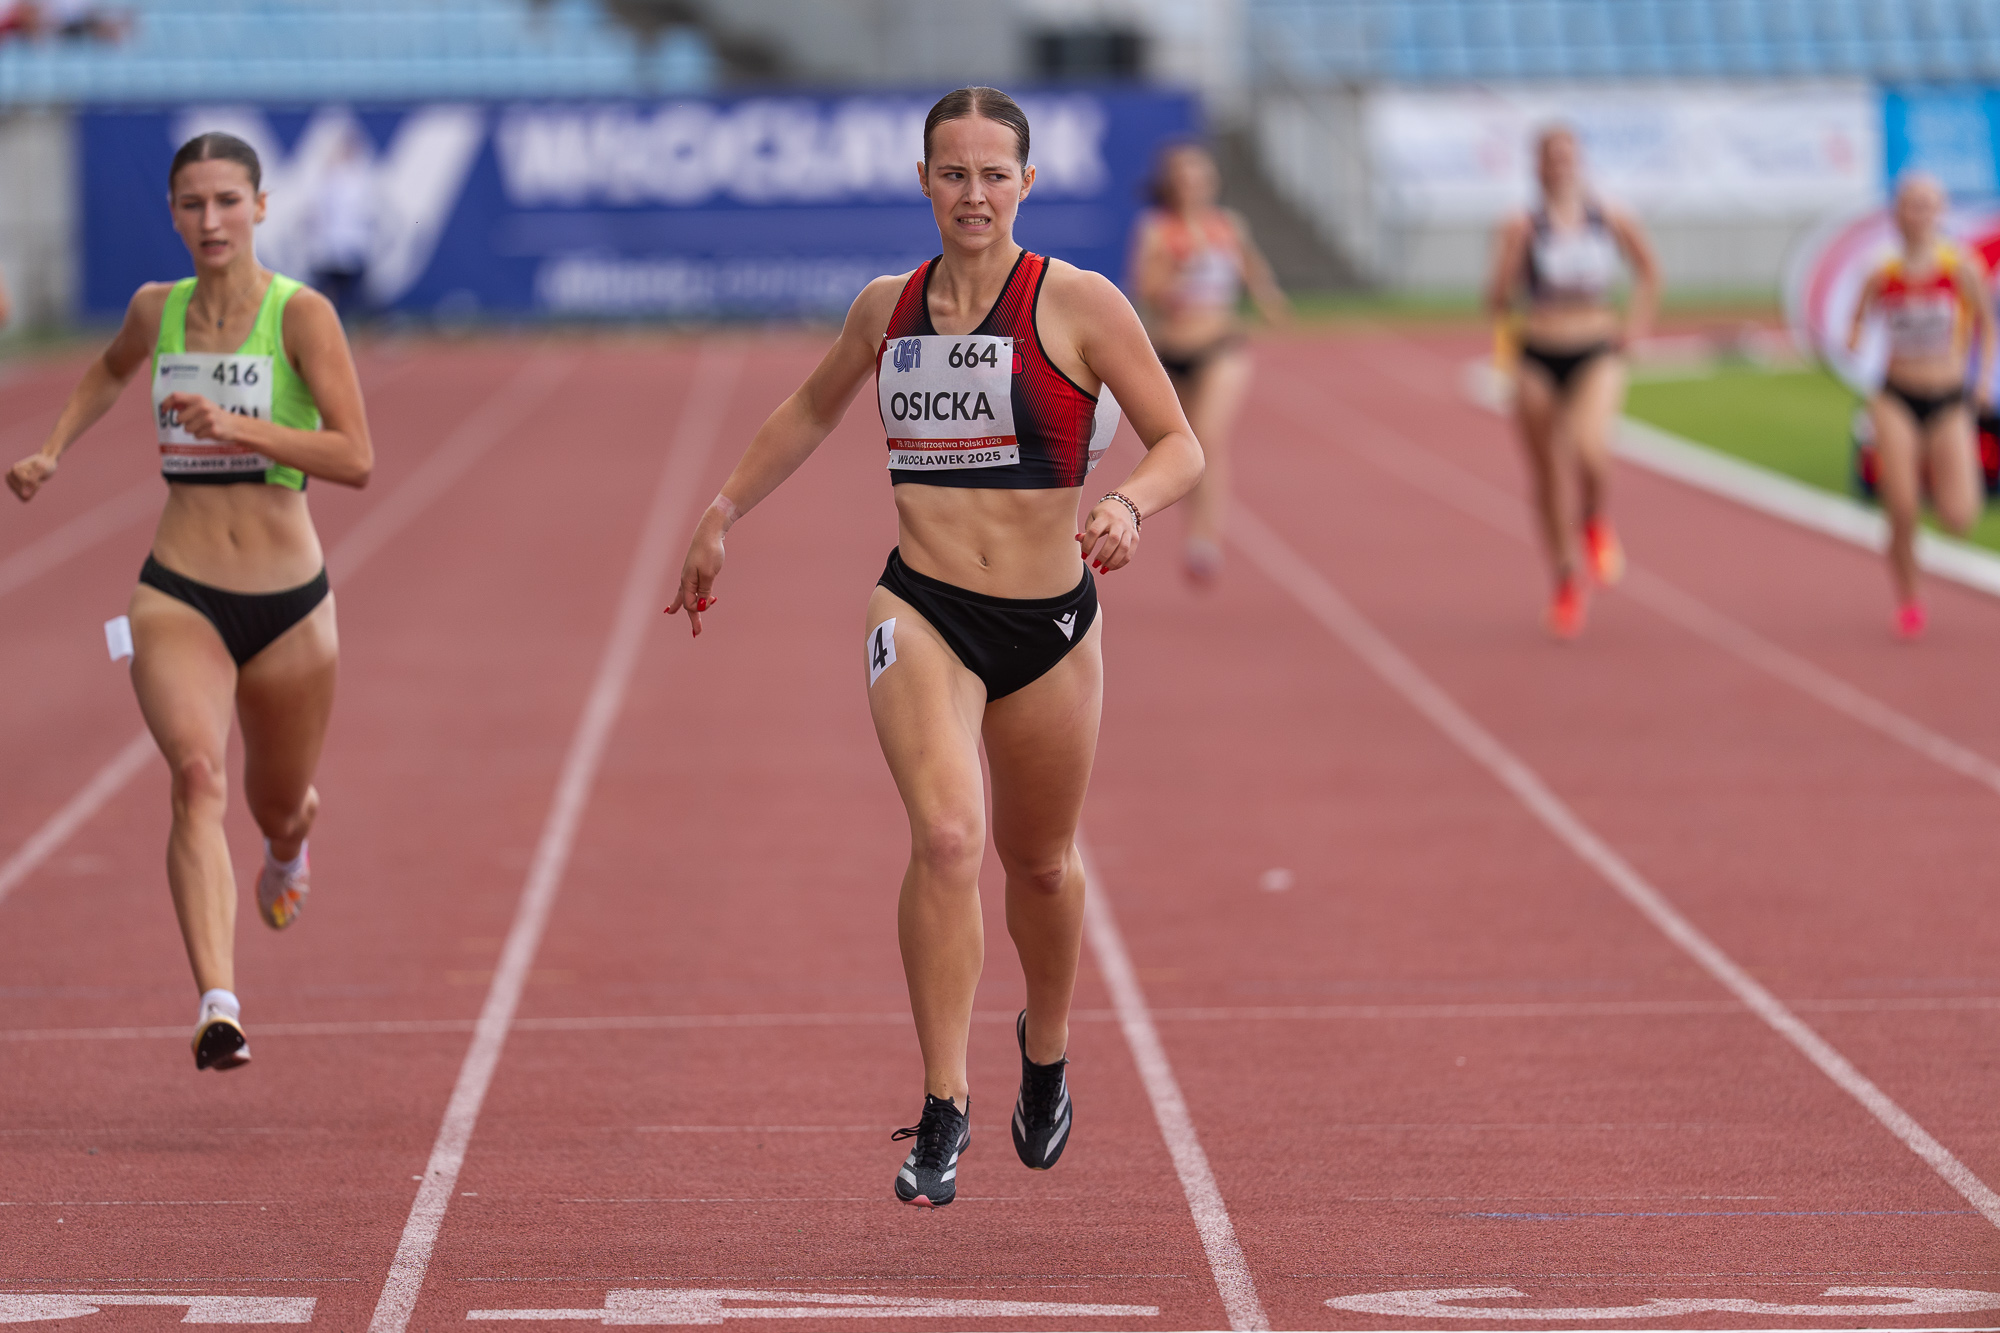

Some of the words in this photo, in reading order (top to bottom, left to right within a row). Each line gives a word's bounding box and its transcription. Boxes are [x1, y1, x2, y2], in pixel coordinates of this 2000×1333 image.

[948, 343, 998, 369] 664
[212, 360, 259, 386] 416
[890, 391, 995, 421] OSICKA
[959, 438, 984, 448] Polski
[985, 437, 1002, 446] U20
[897, 454, 965, 466] WŁOCŁAWEK
[967, 451, 1001, 463] 2025
[872, 626, 888, 672] 4
[466, 1288, 1159, 1325] 4
